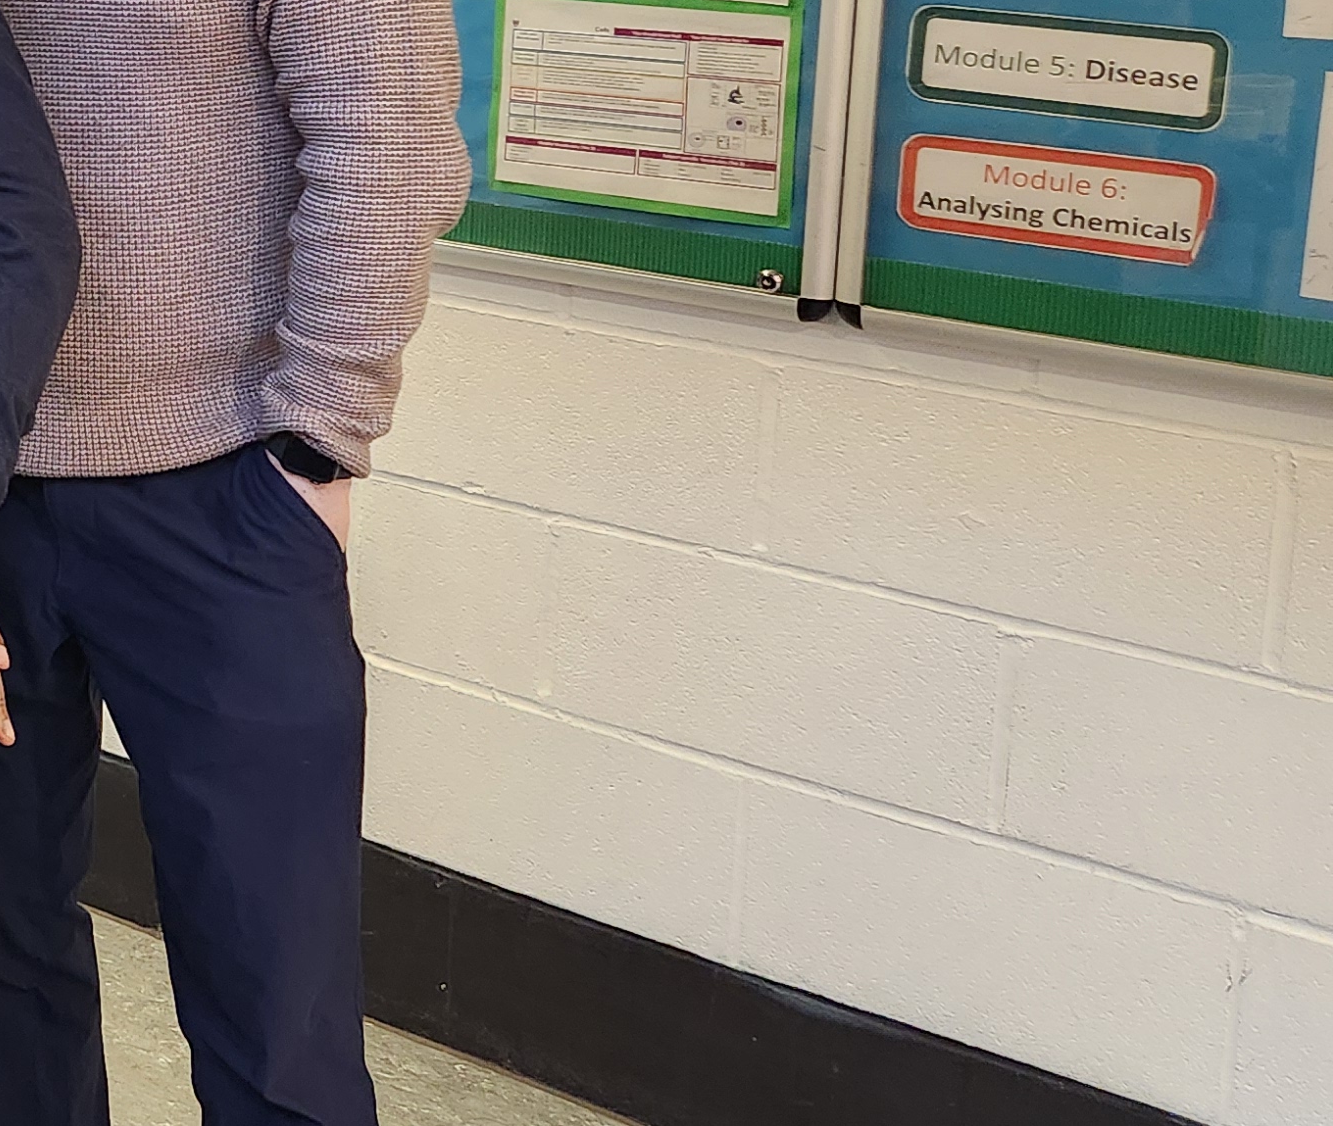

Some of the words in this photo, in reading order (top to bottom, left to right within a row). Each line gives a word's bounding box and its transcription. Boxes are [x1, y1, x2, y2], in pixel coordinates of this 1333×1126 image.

[934, 43, 1040, 74] Module
[1049, 55, 1075, 78] 5:
[1084, 58, 1198, 92] Disease
[983, 163, 1090, 196] Module
[1101, 176, 1127, 201] 6:
[917, 191, 1044, 228] Analysing
[1052, 207, 1192, 244] Chemicals
